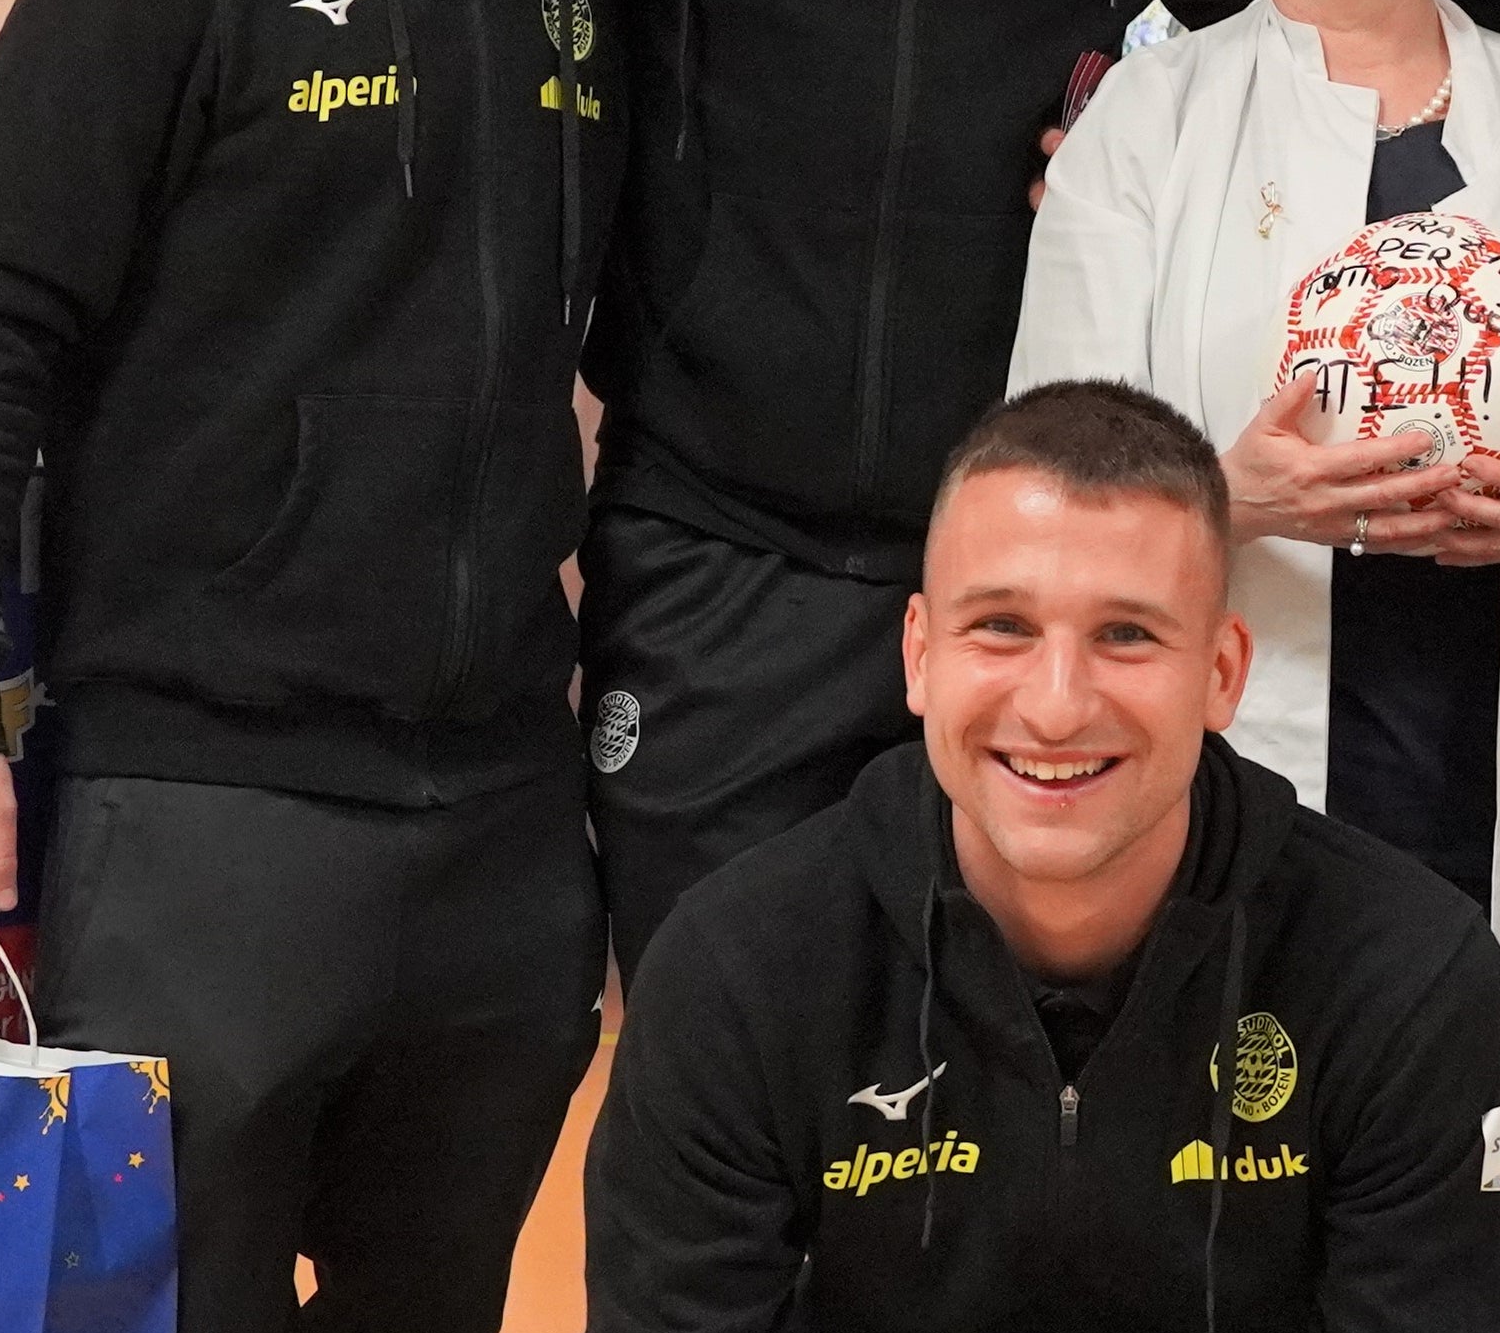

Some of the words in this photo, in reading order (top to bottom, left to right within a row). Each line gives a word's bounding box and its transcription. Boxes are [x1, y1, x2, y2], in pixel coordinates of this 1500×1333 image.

[1376, 237, 1452, 271] PER
[1261, 1071, 1291, 1113] BOZEN
[823, 1130, 981, 1198] alperia
[1236, 1143, 1311, 1183] duk
